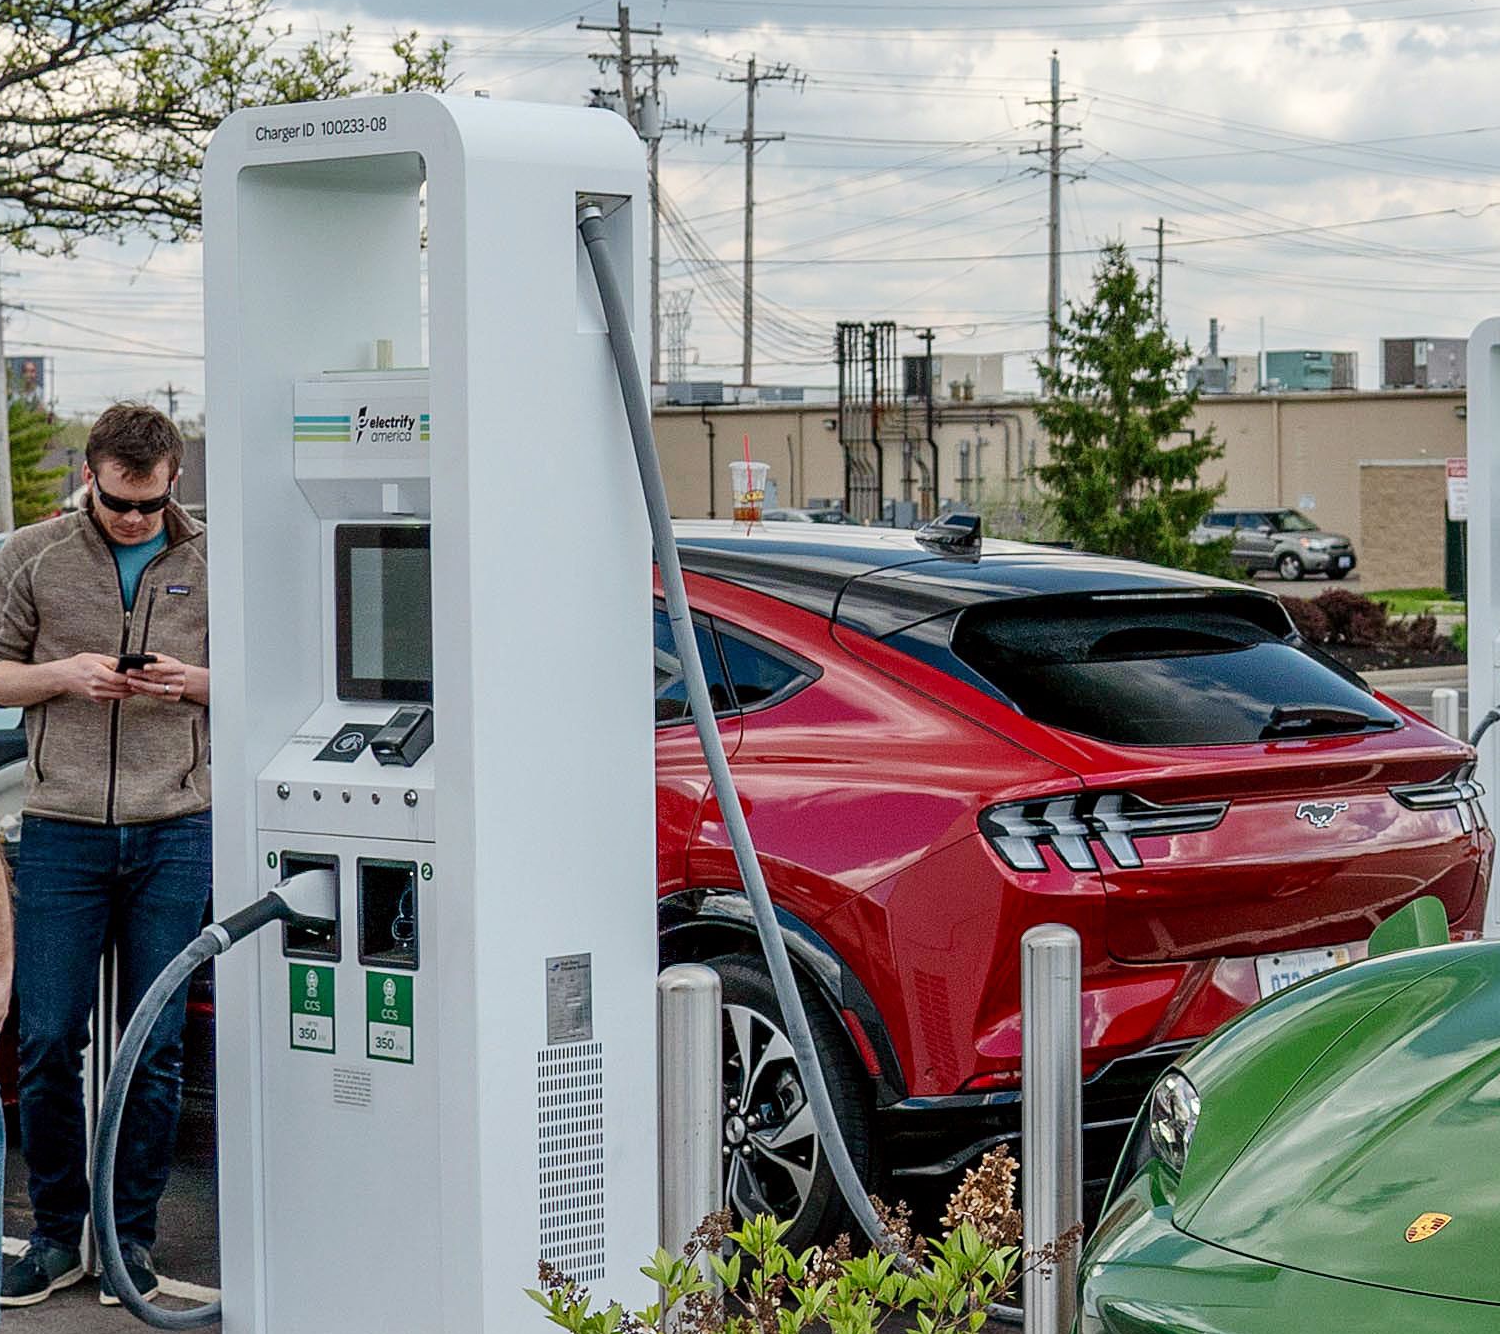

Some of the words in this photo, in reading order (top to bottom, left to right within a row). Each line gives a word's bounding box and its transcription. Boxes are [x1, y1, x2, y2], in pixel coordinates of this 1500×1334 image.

[255, 126, 301, 143] Charger
[302, 122, 315, 138] ID
[320, 116, 387, 135] 100233-08
[369, 414, 415, 431] electrify
[371, 431, 412, 443] america
[268, 853, 276, 867] 1
[422, 864, 432, 879] 2
[304, 1000, 321, 1012] CCS
[381, 1009, 398, 1021] CCS
[299, 1027, 317, 1041] 350
[375, 1036, 394, 1050] 350
